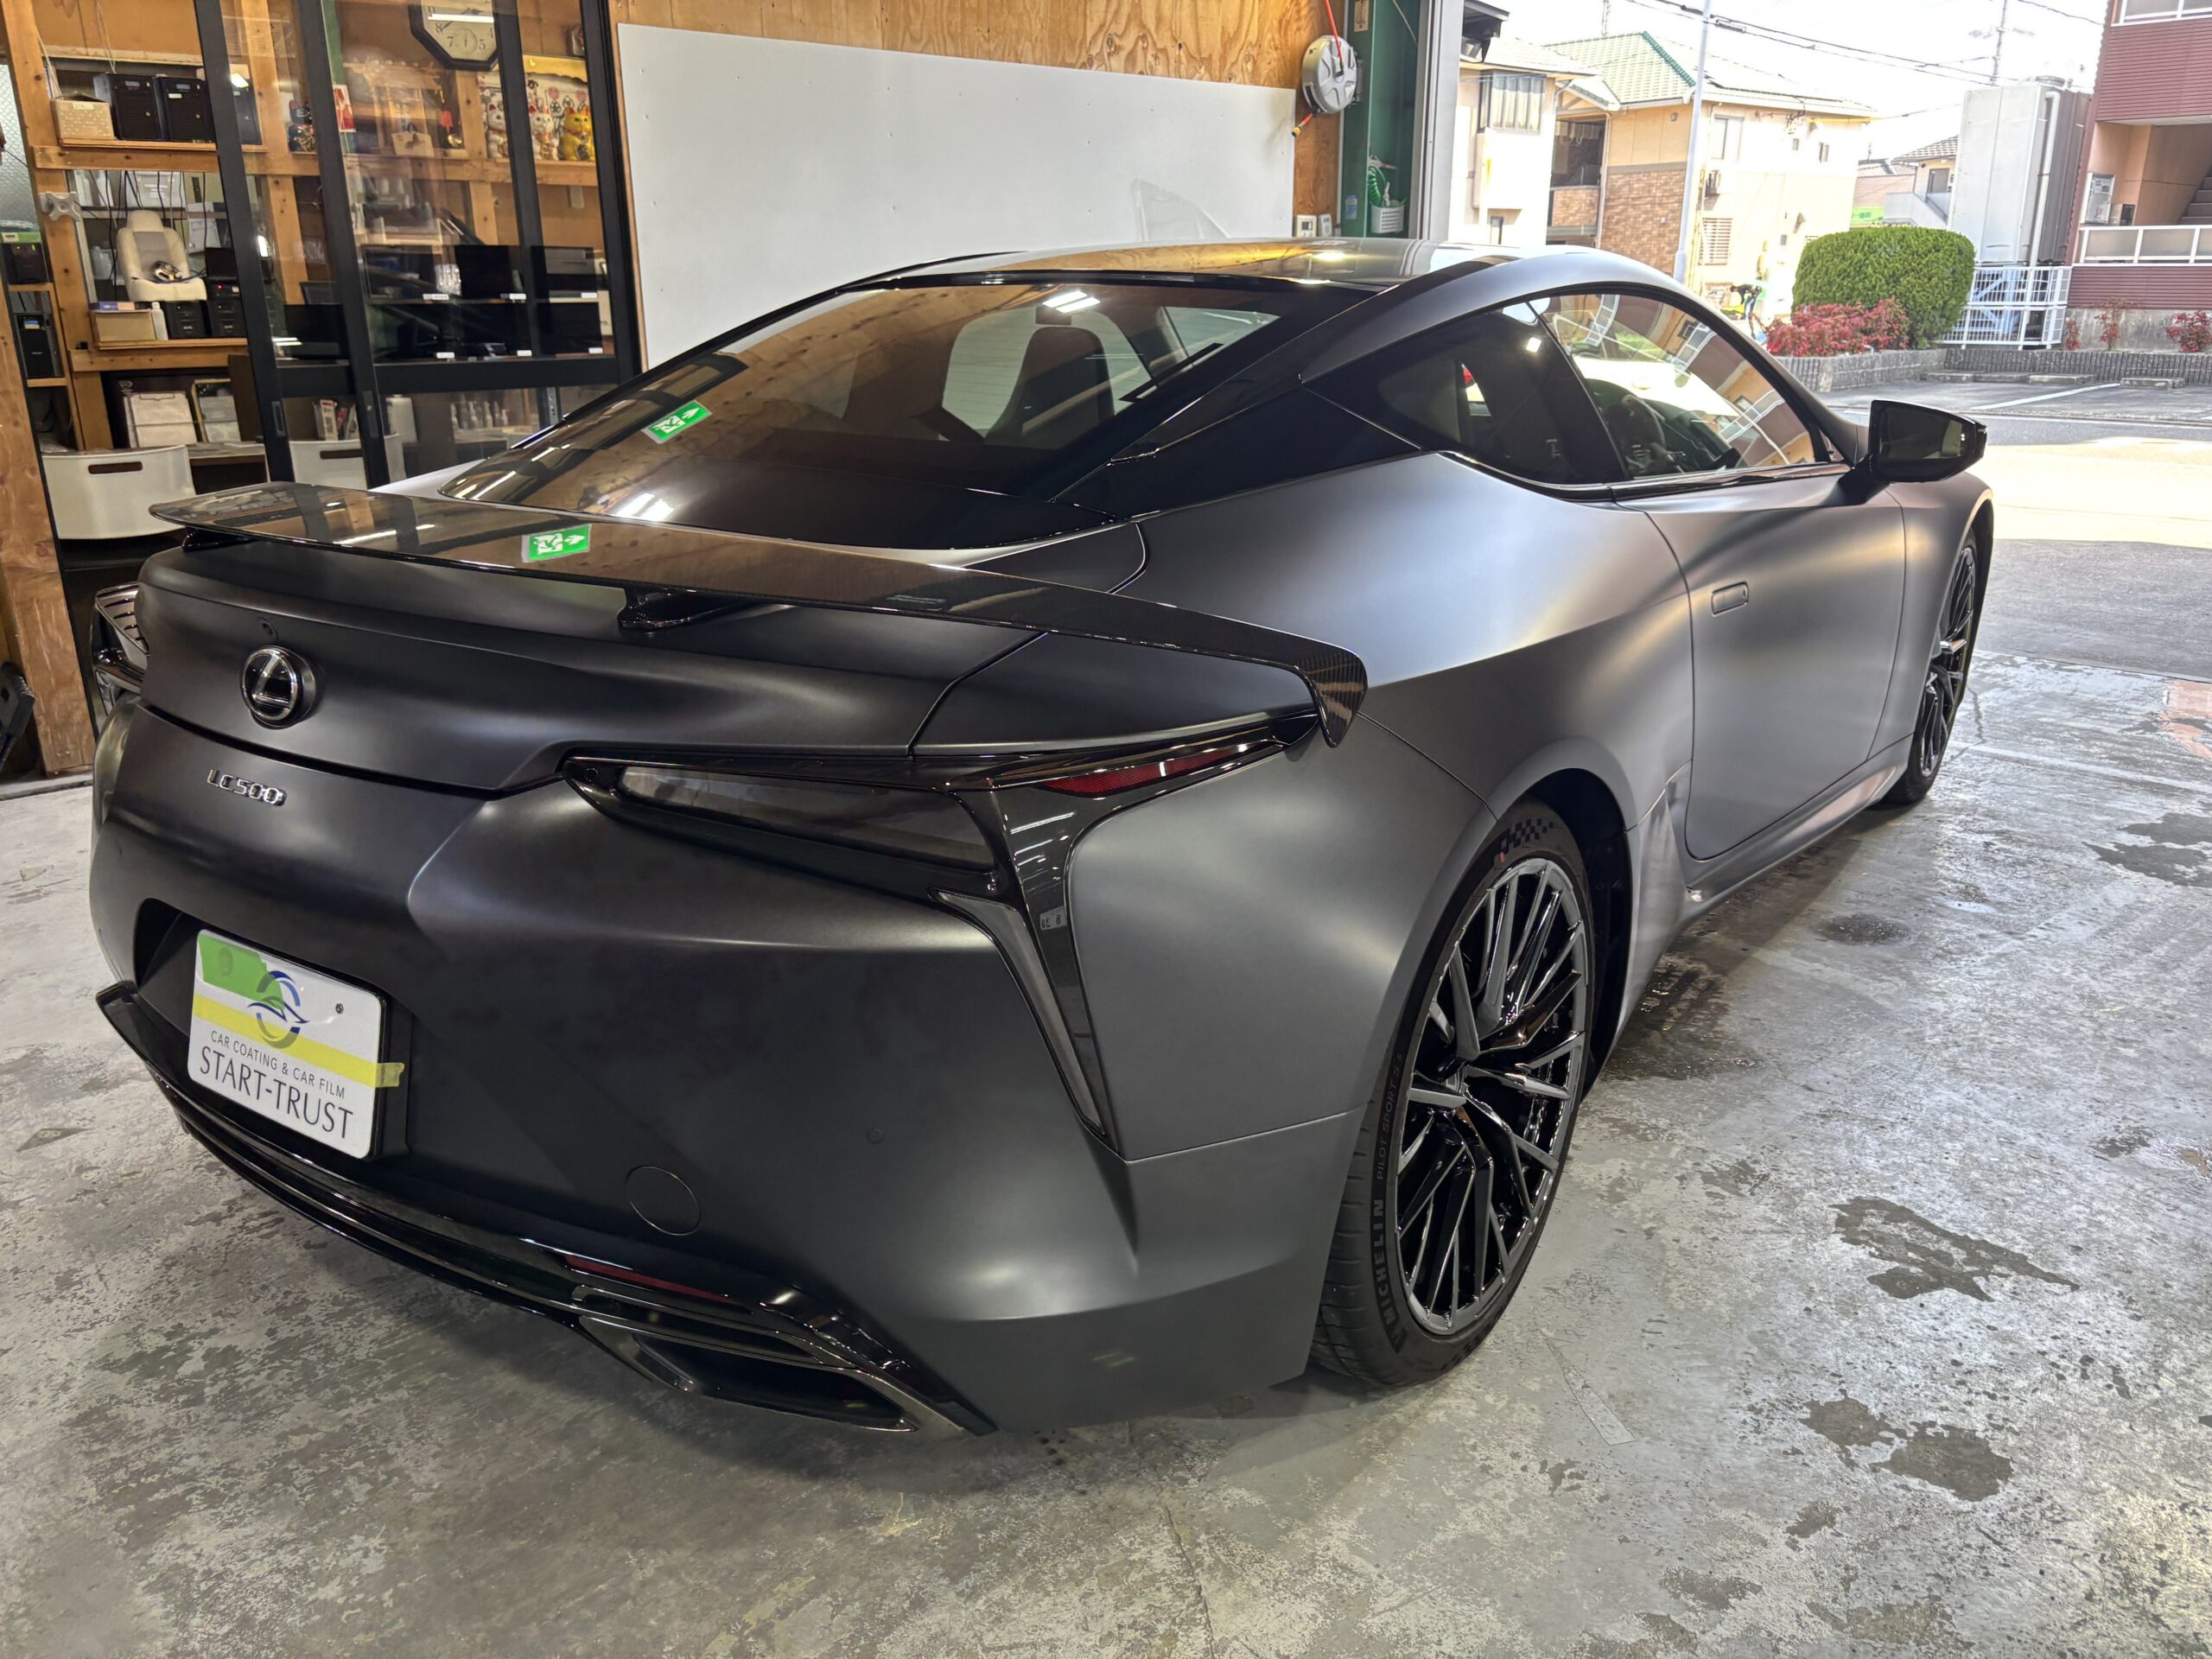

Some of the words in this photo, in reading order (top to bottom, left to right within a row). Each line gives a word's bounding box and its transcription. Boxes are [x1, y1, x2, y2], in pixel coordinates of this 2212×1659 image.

[207, 769, 283, 805] LC500
[200, 1046, 353, 1139] START-TRUST
[211, 1030, 230, 1047] CAR
[232, 1040, 277, 1071] COATING
[282, 1062, 289, 1075] &
[293, 1067, 315, 1086] CAR
[319, 1077, 345, 1099] FILM
[1376, 1140, 1388, 1180] PILOT
[1382, 1080, 1396, 1133] SPORT
[1373, 1198, 1397, 1325] MICHELIN
